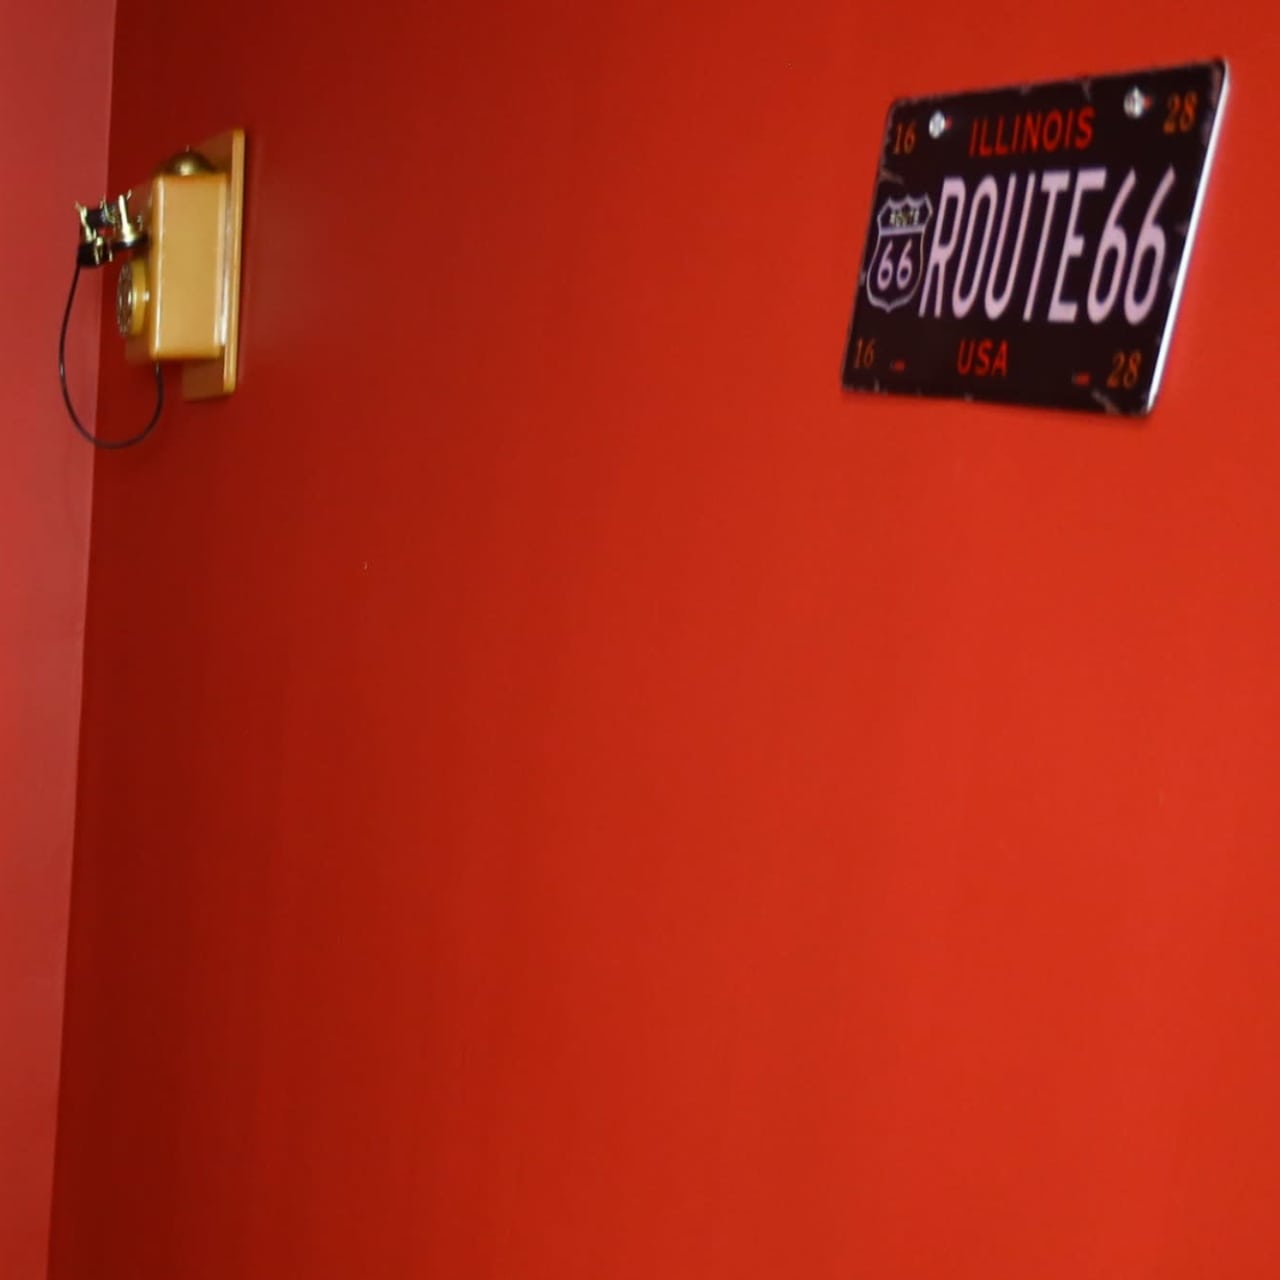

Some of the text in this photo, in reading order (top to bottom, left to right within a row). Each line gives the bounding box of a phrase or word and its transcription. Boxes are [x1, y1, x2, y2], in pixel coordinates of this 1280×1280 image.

[969, 105, 1097, 157] ILLINOIS
[1163, 92, 1198, 134] 28
[892, 122, 917, 155] 16
[877, 239, 913, 291] 66
[853, 337, 876, 370] 16
[956, 338, 1010, 378] USA
[1106, 351, 1143, 390] 28
